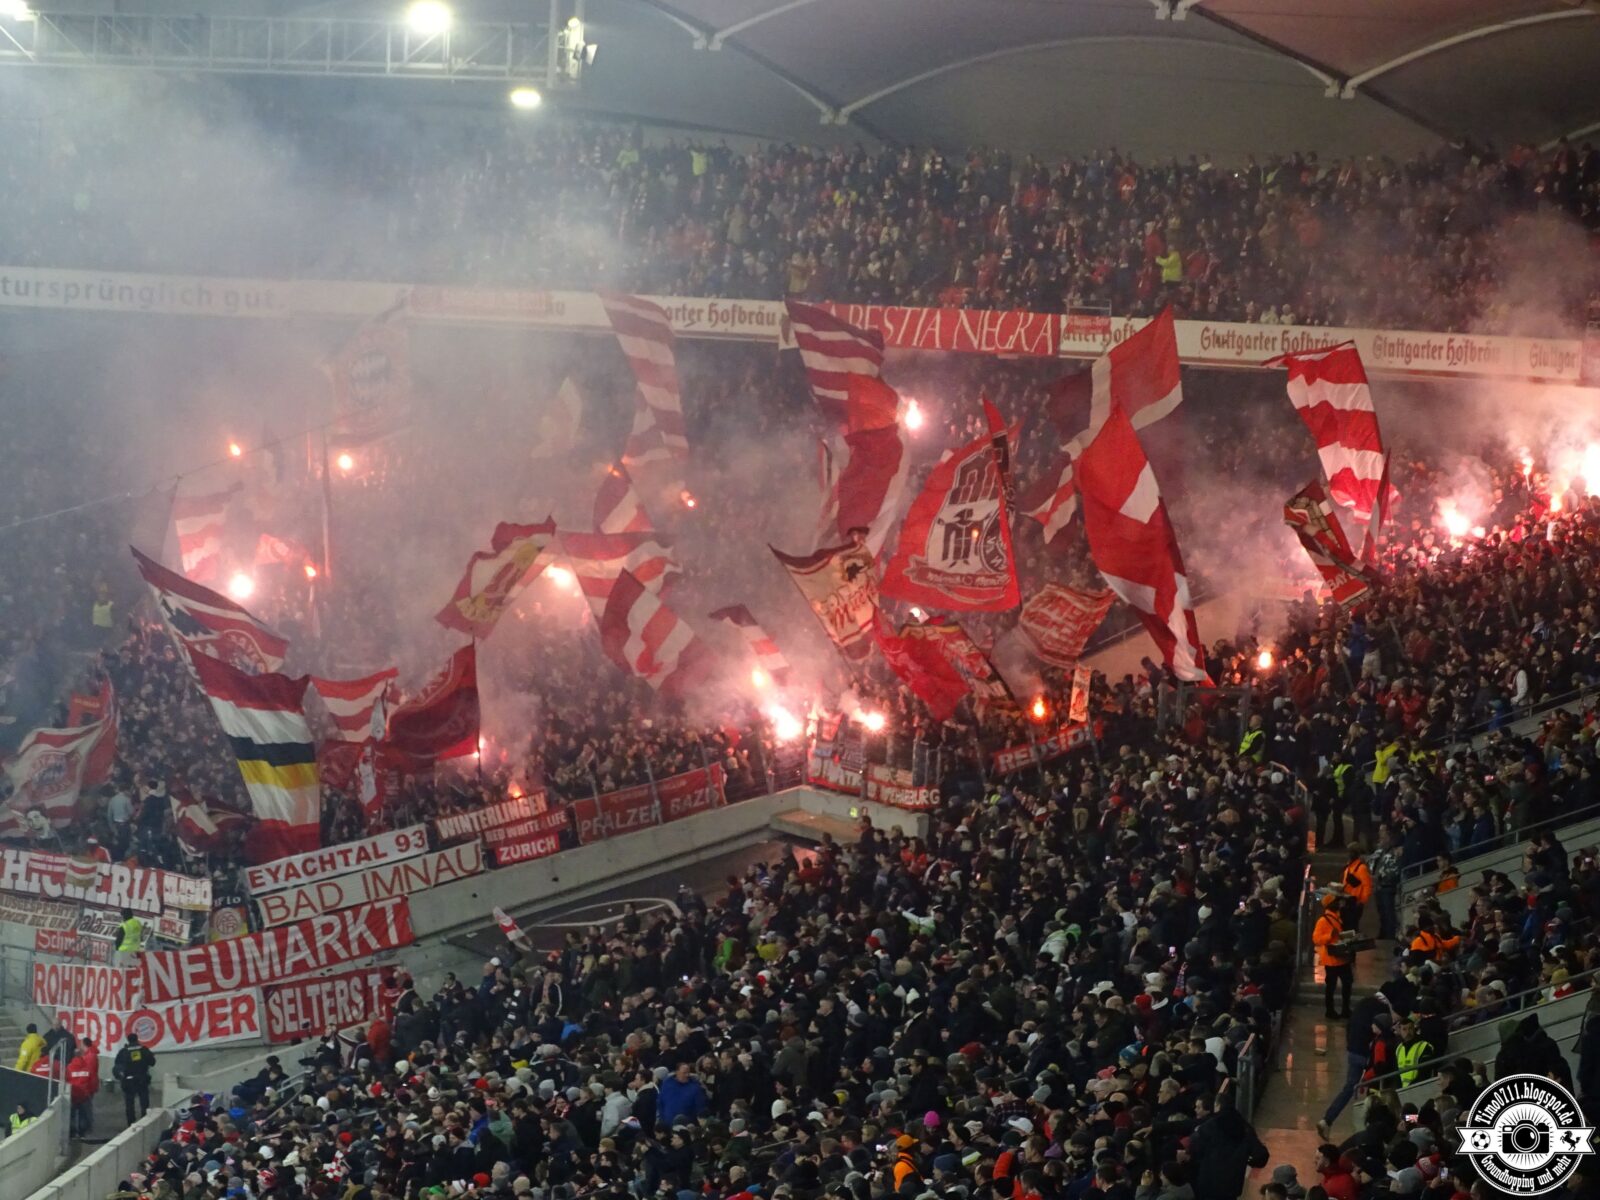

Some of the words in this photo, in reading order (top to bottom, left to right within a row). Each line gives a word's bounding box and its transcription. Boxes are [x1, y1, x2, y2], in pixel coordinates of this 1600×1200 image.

[708, 302, 777, 328] Hofbräu
[849, 304, 942, 349] BESTIA
[951, 308, 1053, 355] NEGRA
[1200, 326, 1277, 356] Stuttgarter
[1372, 334, 1444, 366] Stuttgarter
[437, 791, 548, 840] WINTERLINGEN
[506, 819, 540, 838] WHITE
[547, 810, 567, 827] LIFE
[249, 842, 387, 889] EYACHTAL
[394, 829, 426, 853] 93
[262, 882, 344, 924] BAD
[362, 843, 481, 900] IMNAU
[145, 899, 403, 1001] NEUMARKT
[33, 963, 141, 1012] ROHRDORF
[269, 974, 364, 1036] SELTERS
